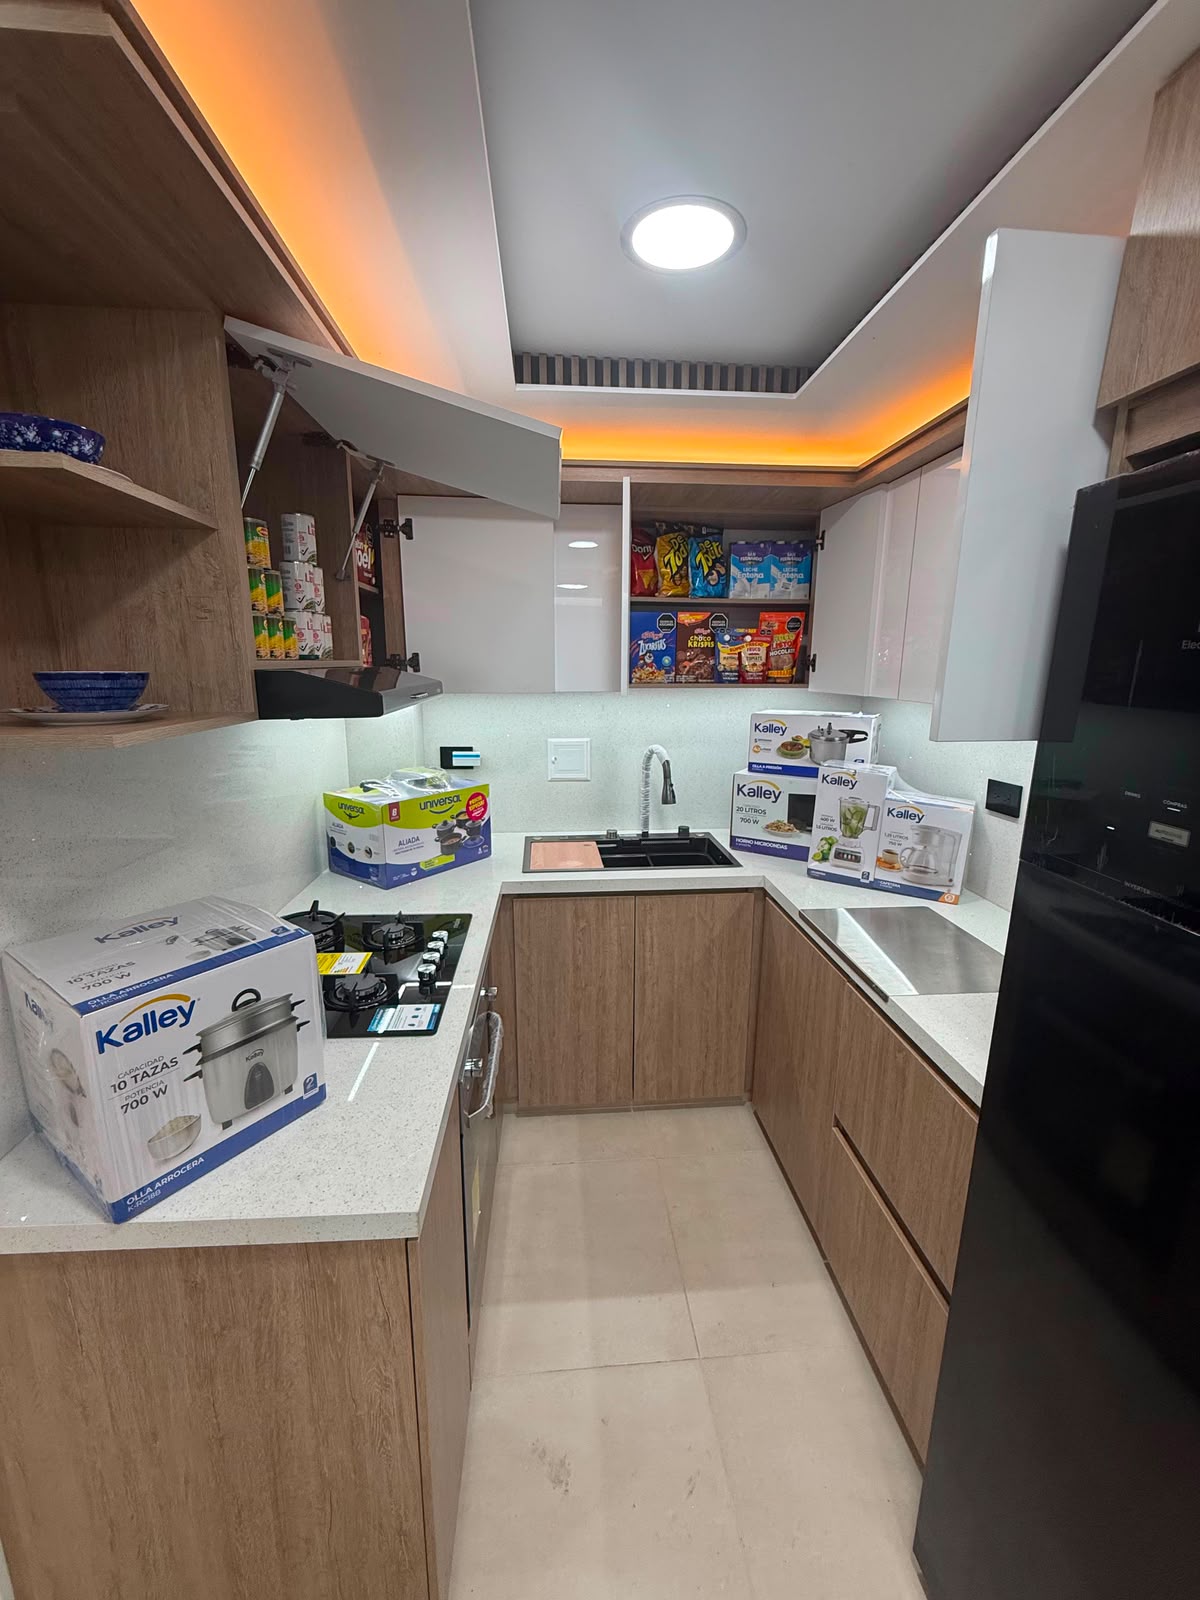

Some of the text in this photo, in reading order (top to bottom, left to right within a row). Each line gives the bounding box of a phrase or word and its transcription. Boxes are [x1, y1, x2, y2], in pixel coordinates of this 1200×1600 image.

[357, 548, 371, 569] oel
[754, 722, 788, 736] Kalley
[822, 774, 858, 790] Kalley
[419, 795, 461, 810] universal
[737, 784, 782, 803] Kalley
[338, 802, 365, 815] universal
[745, 808, 767, 816] LITROS
[1163, 799, 1188, 809] COMPRAS
[887, 808, 925, 823] Kalley
[398, 835, 420, 846] ALIADA
[754, 841, 788, 850] MICROONDAS
[862, 871, 869, 880] 2
[94, 917, 178, 944] Kalley
[66, 977, 84, 985] 10
[86, 961, 136, 978] TAZAS
[81, 979, 112, 991] 700
[115, 972, 131, 980] W
[87, 993, 117, 1005] OLLA
[118, 973, 174, 995] ARROCERA
[96, 1000, 196, 1055] Kalley
[110, 1057, 179, 1094] 10 TAZAS
[117, 1055, 165, 1080] CAPACIDAD
[124, 1080, 165, 1101] POTENCIA
[305, 1076, 314, 1090] 2
[120, 1084, 168, 1115] 700 W
[126, 1157, 205, 1205] OLLA ARROCERA
